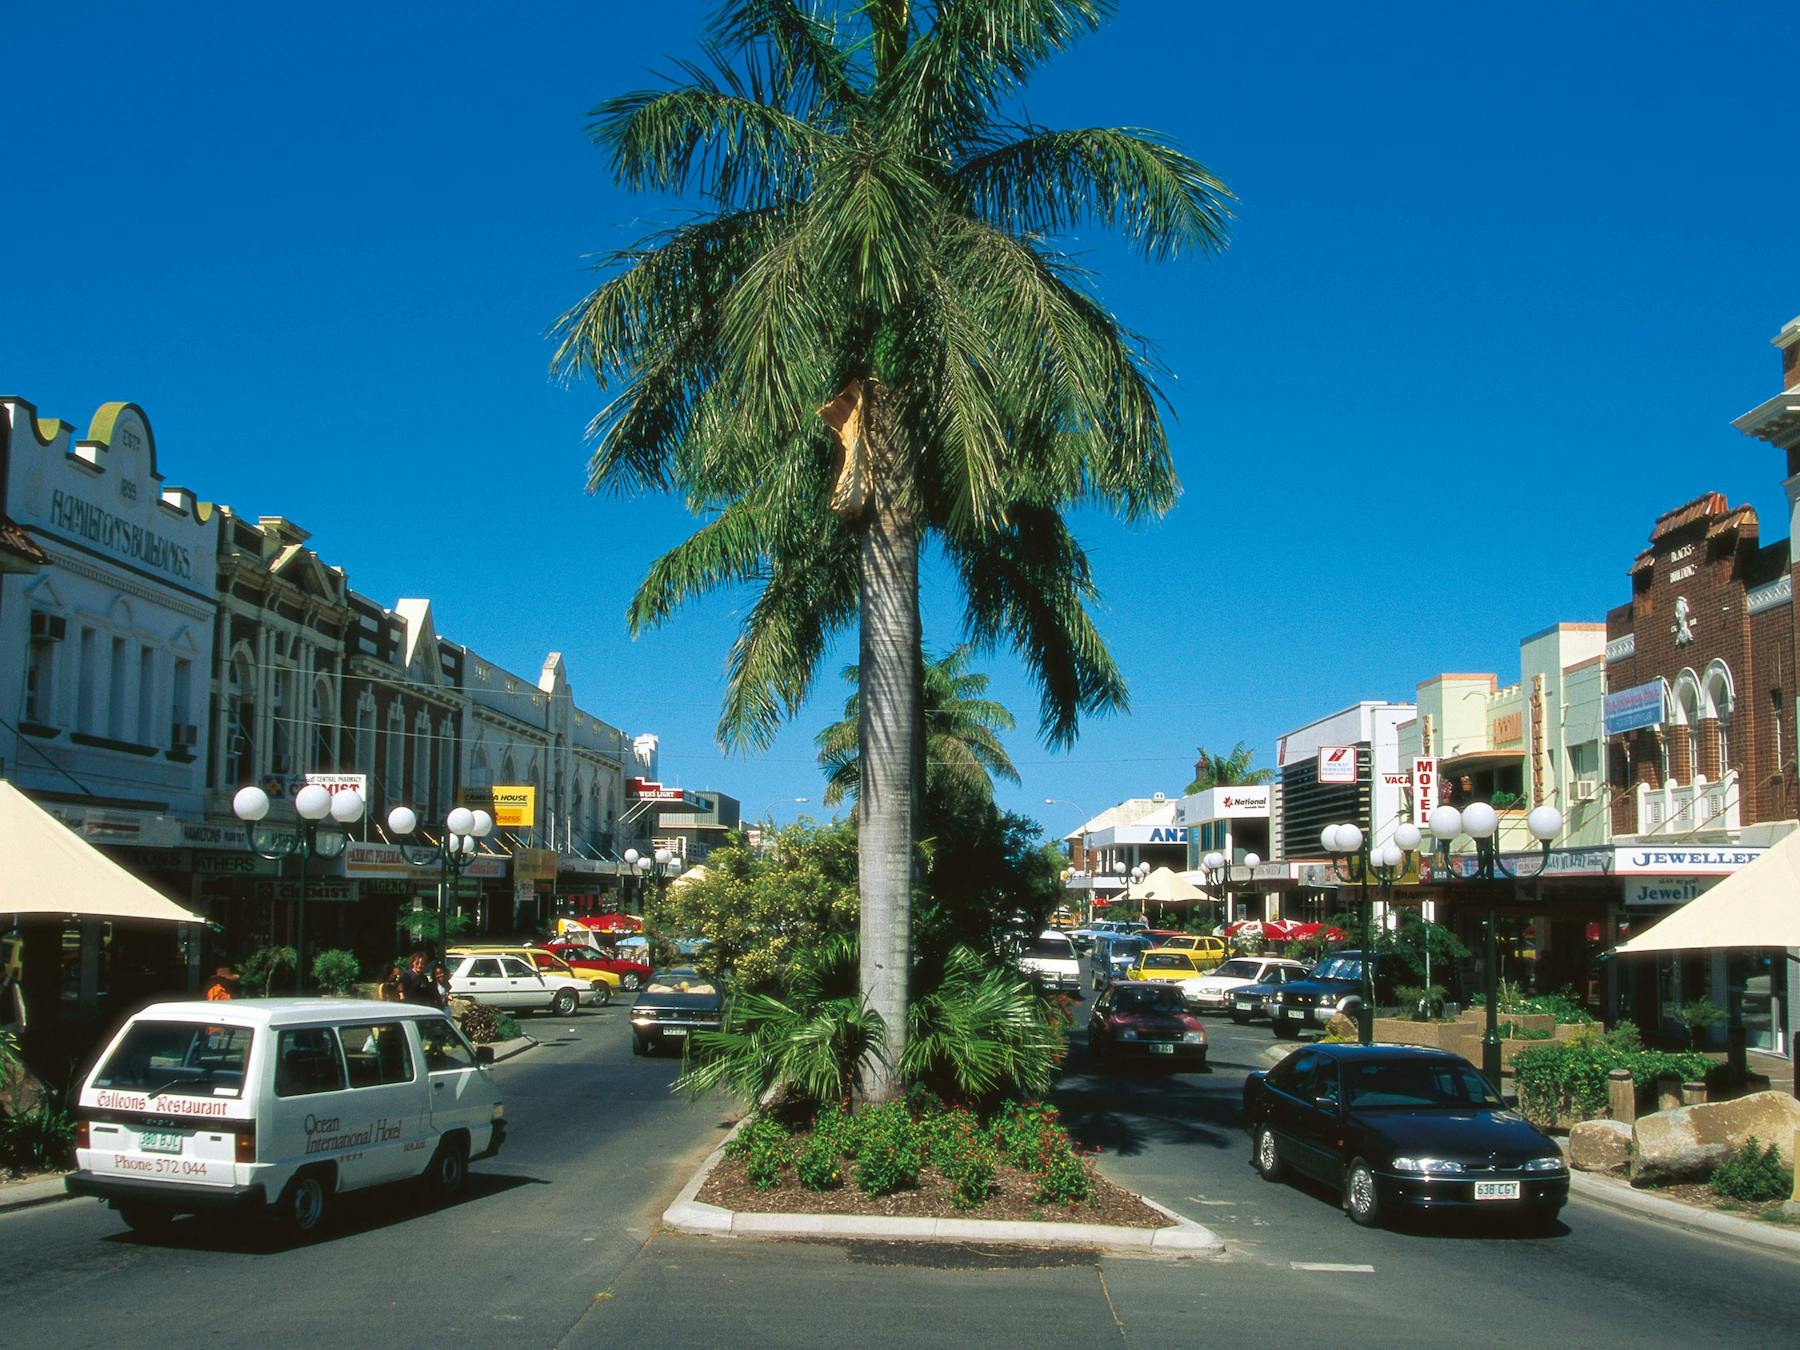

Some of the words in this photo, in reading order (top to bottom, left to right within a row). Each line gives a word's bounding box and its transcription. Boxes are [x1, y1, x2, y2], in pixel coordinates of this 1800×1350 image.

[1234, 797, 1266, 805] National
[1416, 761, 1433, 823] MOTEL
[1149, 828, 1188, 841] ANZ
[1433, 871, 1448, 879] BAR
[156, 1096, 228, 1116] Restaurant
[304, 1113, 340, 1136] Ocean
[304, 1123, 373, 1154] International
[376, 1118, 401, 1143] Hotel
[114, 1154, 153, 1171] Phone
[156, 1159, 179, 1174] 572
[182, 1161, 208, 1175] 044
